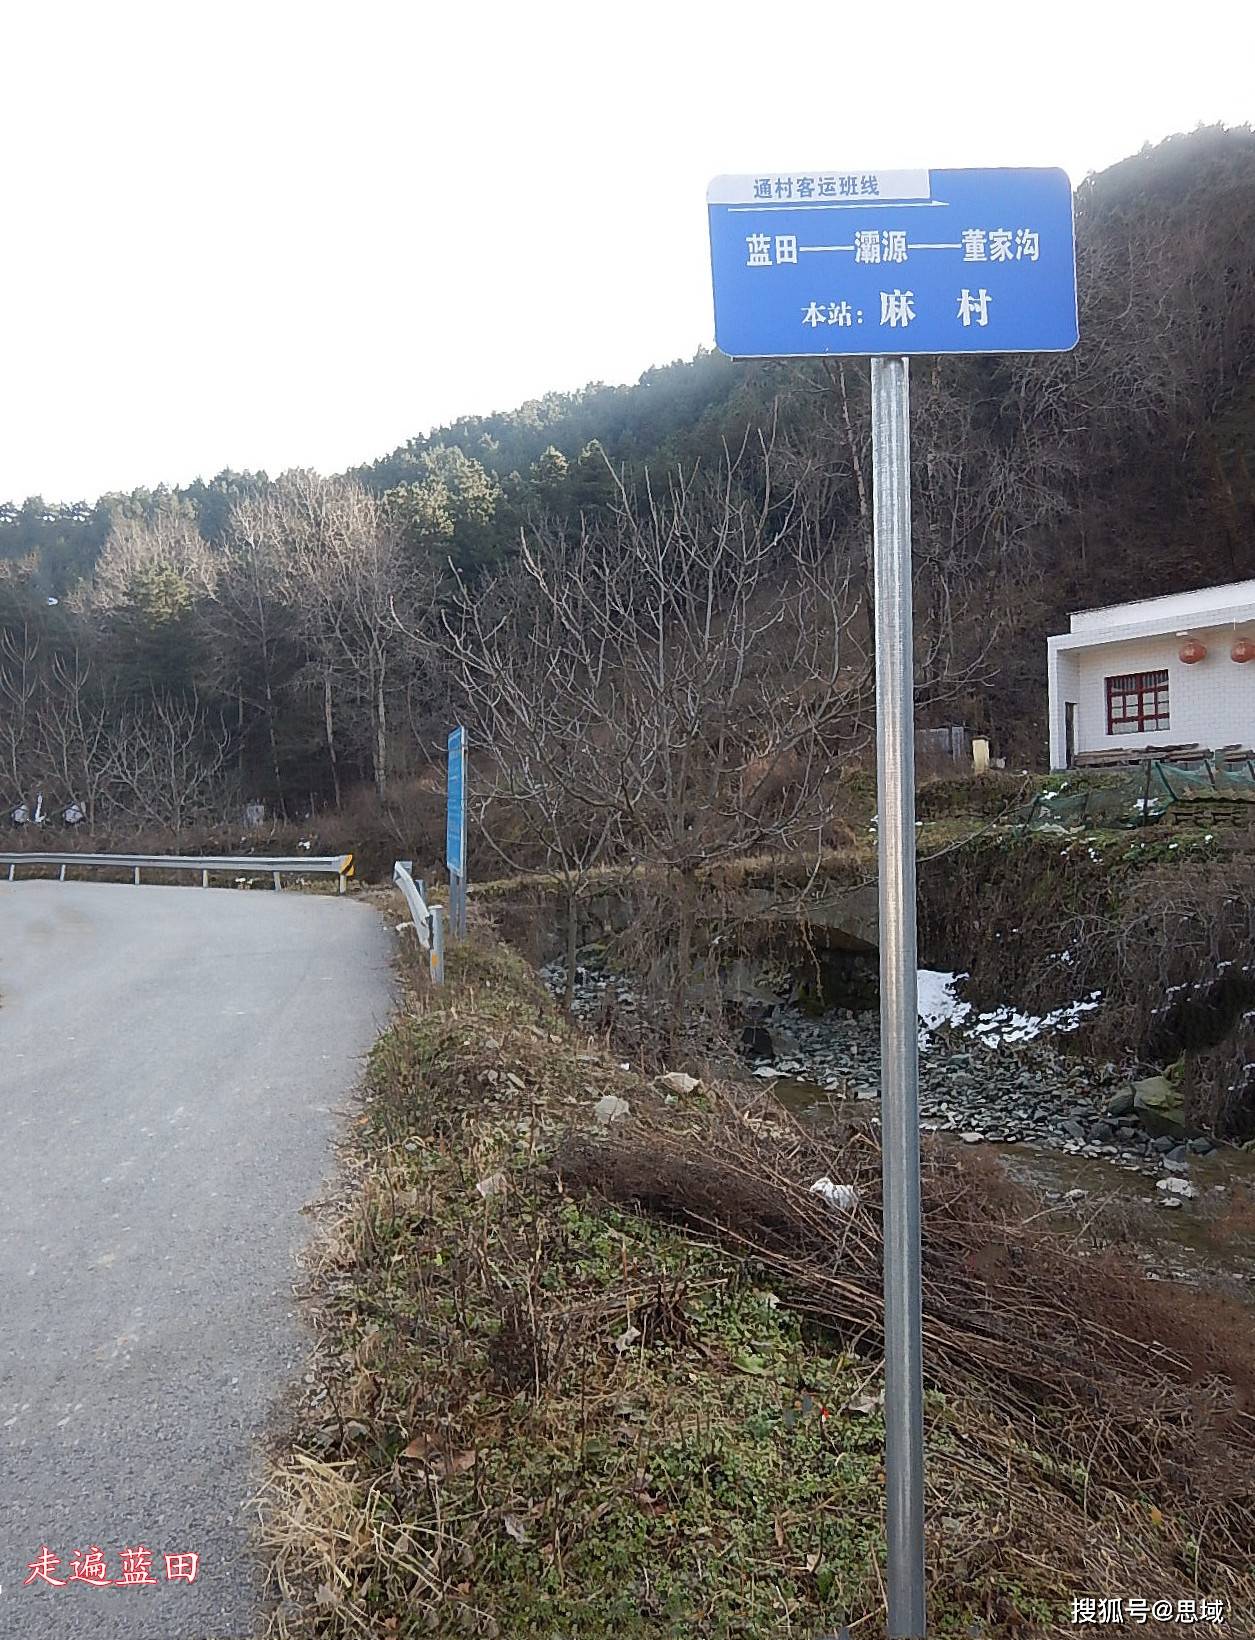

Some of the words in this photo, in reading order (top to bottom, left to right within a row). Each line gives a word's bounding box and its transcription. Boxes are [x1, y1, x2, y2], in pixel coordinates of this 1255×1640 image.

[753, 175, 880, 199] 通村客运班线
